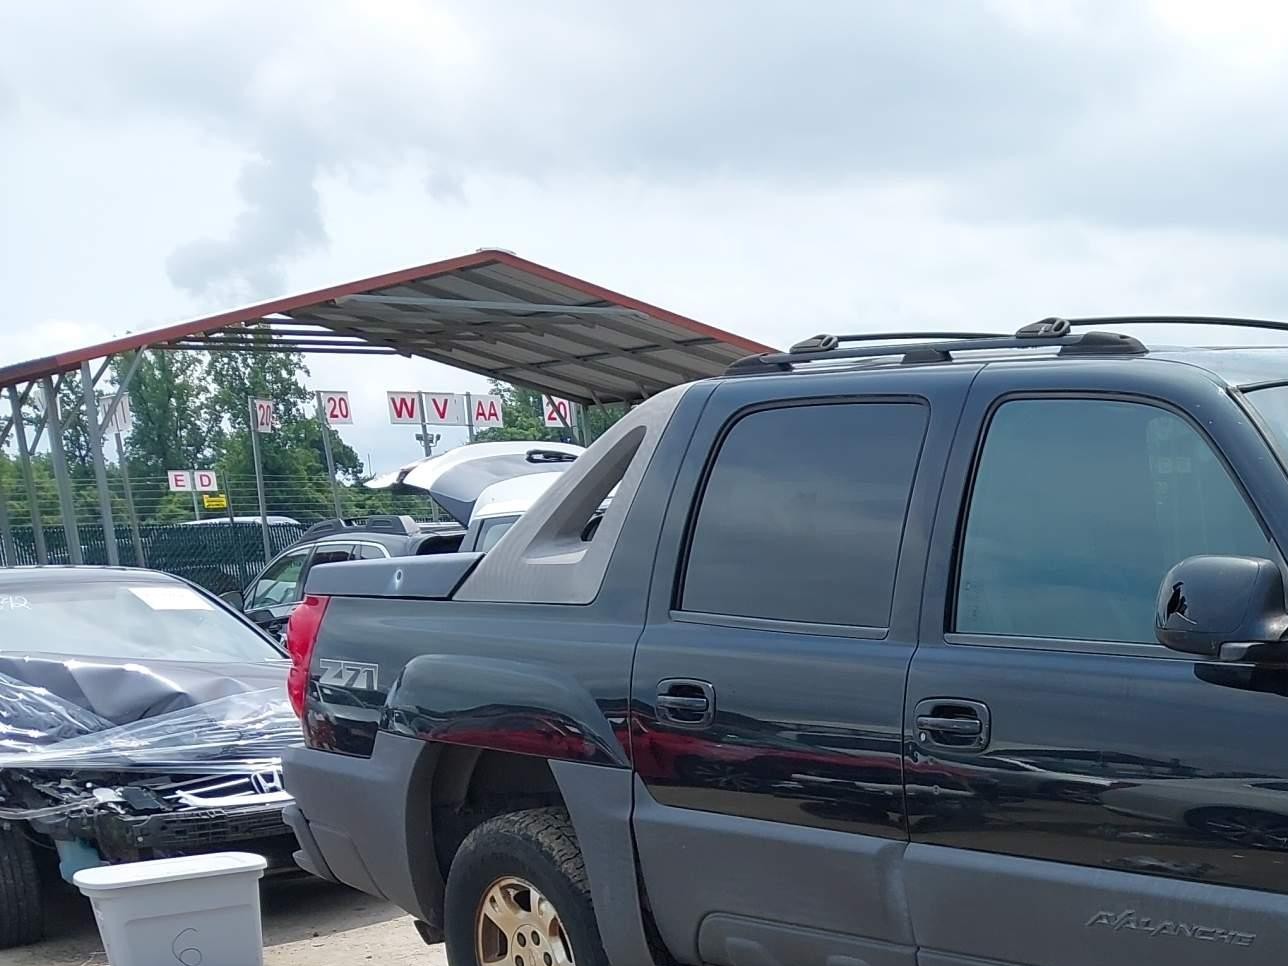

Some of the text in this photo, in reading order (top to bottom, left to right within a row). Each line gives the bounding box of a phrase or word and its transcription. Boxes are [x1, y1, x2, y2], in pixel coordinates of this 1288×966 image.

[258, 404, 272, 426] 20
[326, 396, 349, 419] 20
[390, 397, 416, 419] W
[431, 398, 449, 419] V
[475, 400, 500, 421] AA
[546, 401, 568, 420] 20
[174, 474, 186, 487] E
[199, 474, 211, 487] D
[319, 658, 378, 690] Z71
[1085, 909, 1257, 946] AVALANCHE
